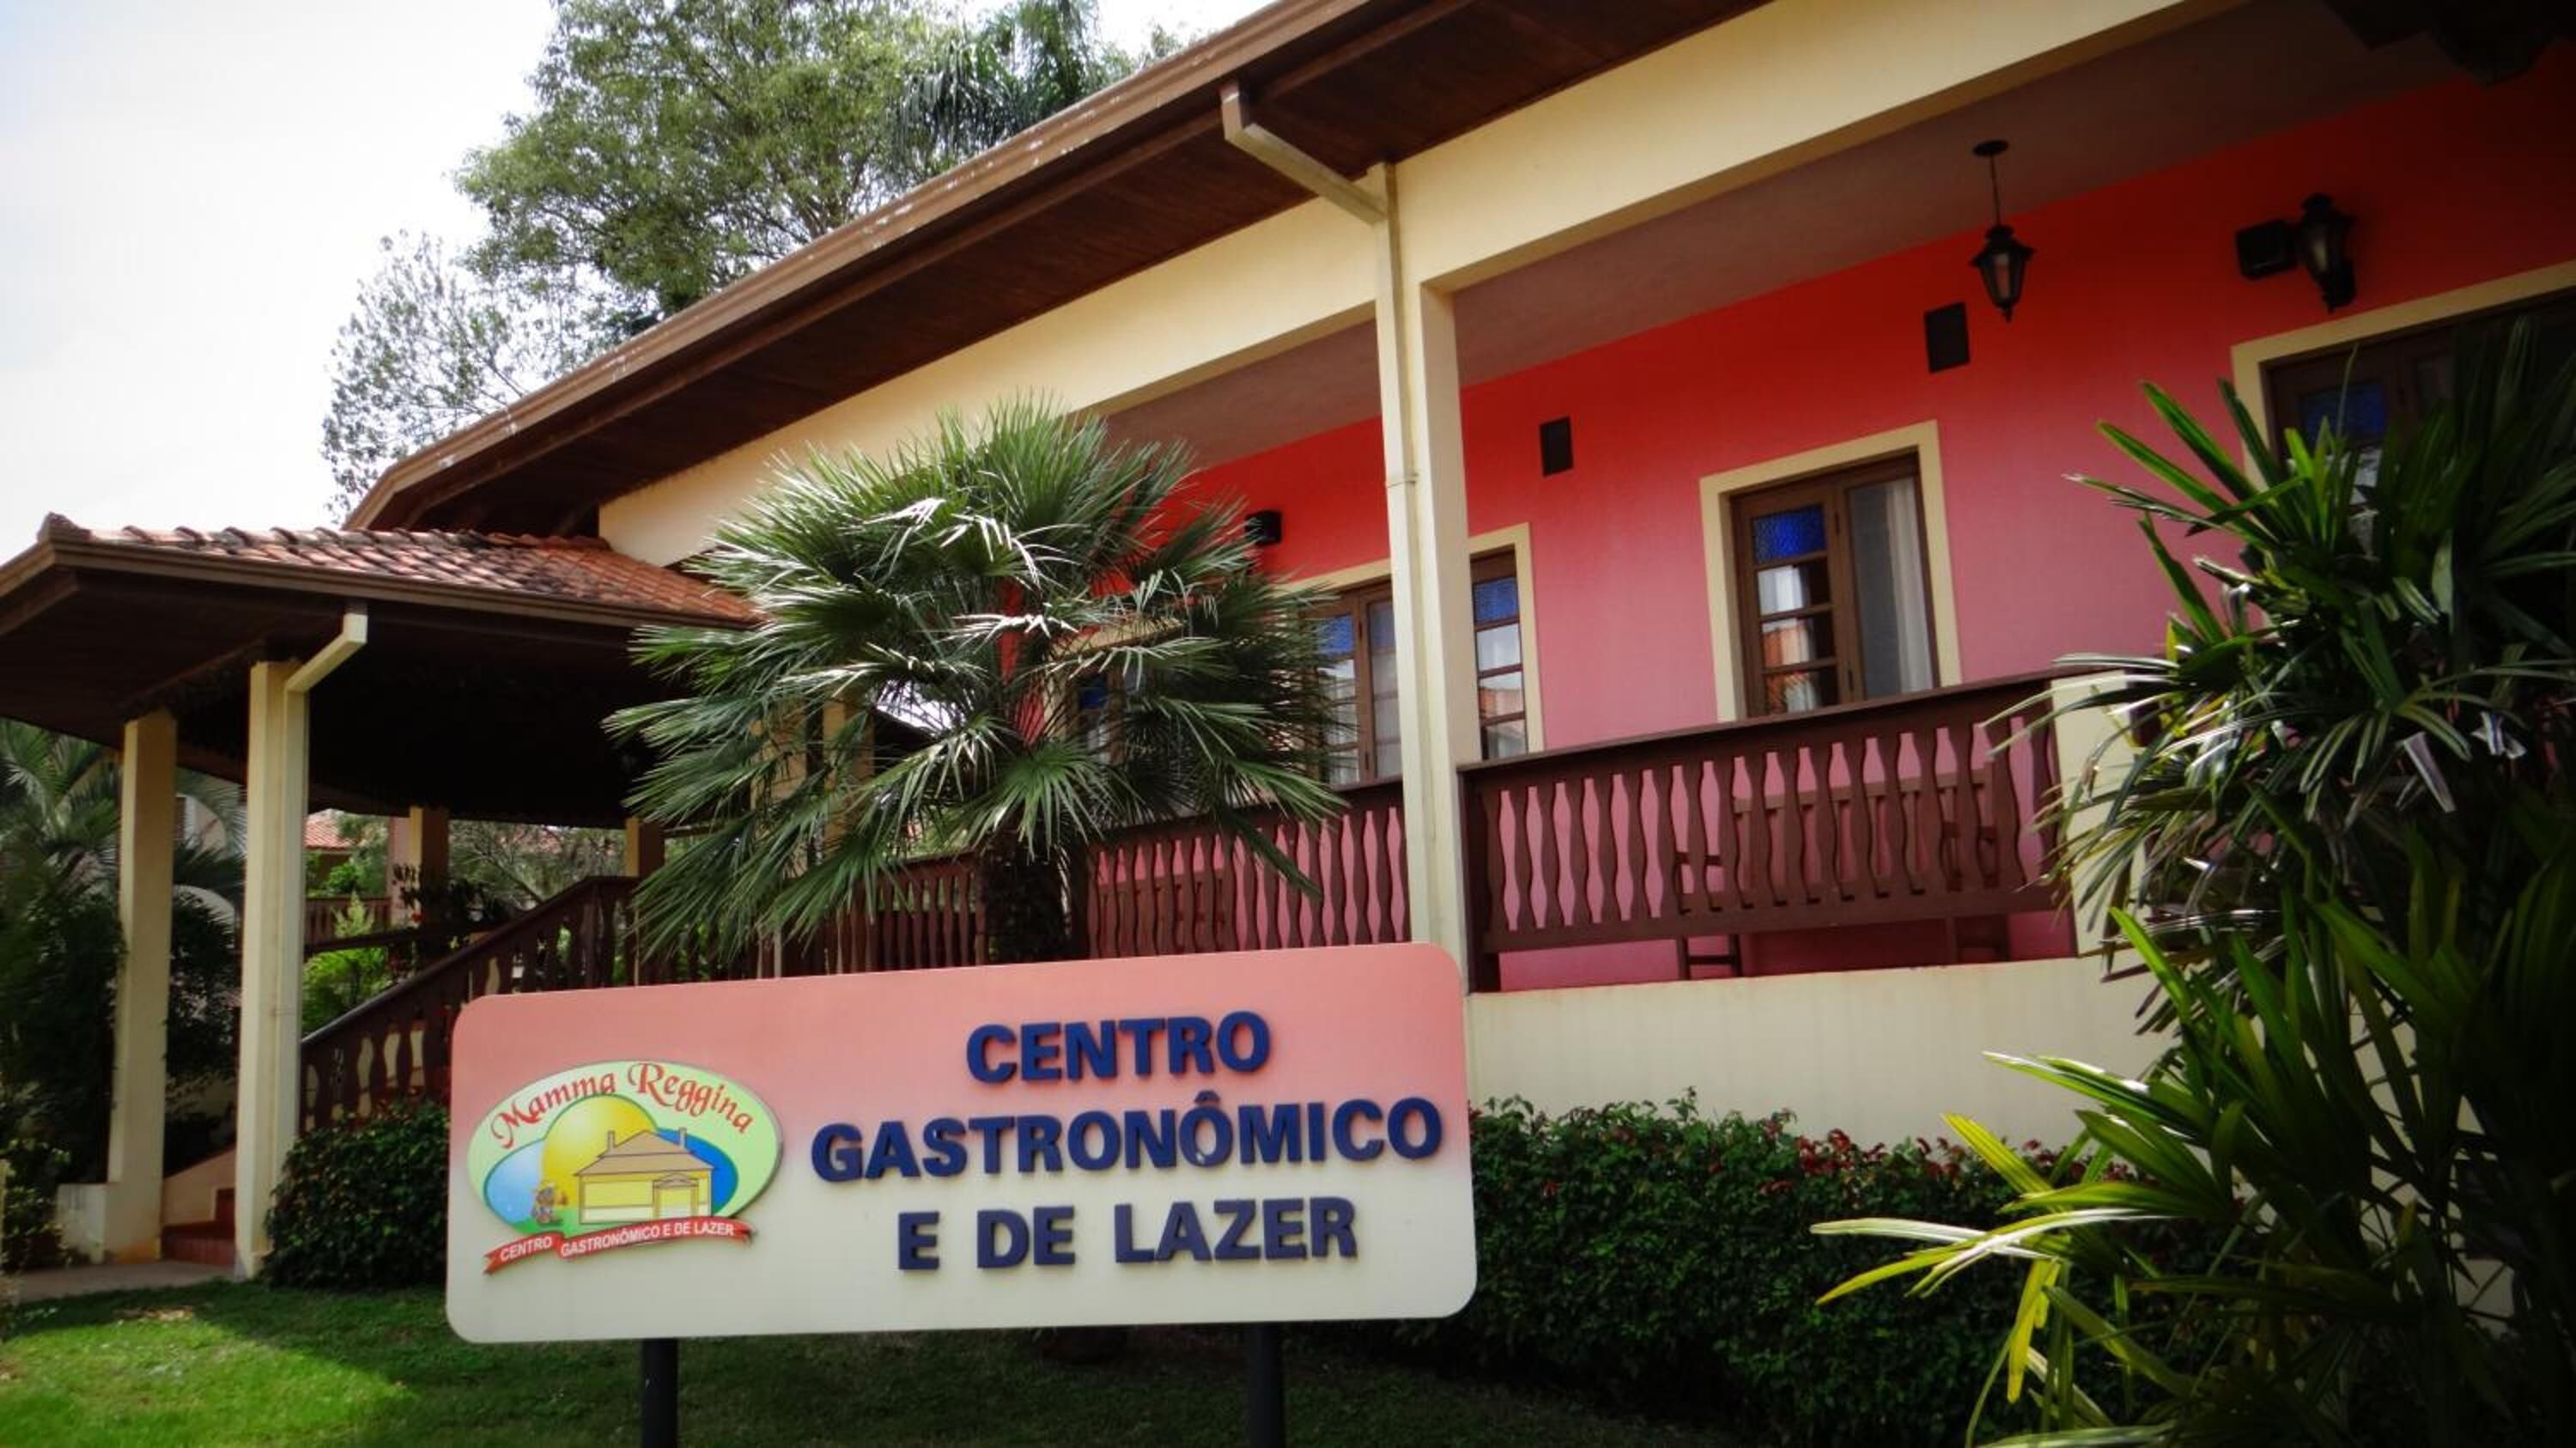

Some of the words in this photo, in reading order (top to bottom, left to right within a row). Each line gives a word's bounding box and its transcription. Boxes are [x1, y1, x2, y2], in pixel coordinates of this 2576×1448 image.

[967, 1011, 1272, 1084] CENTRO
[490, 1073, 617, 1149] Mamma
[628, 1062, 754, 1134] Reggina
[811, 1091, 1443, 1183] GASTRONÔMICO
[500, 1237, 552, 1262] CENTRO
[561, 1226, 659, 1256] GASTRONÔMICO
[663, 1224, 671, 1237] E
[674, 1222, 691, 1236] DE
[694, 1222, 735, 1237] LAZER
[898, 1212, 940, 1270] E
[976, 1206, 1076, 1269] DE
[1115, 1197, 1358, 1264] LAZER
